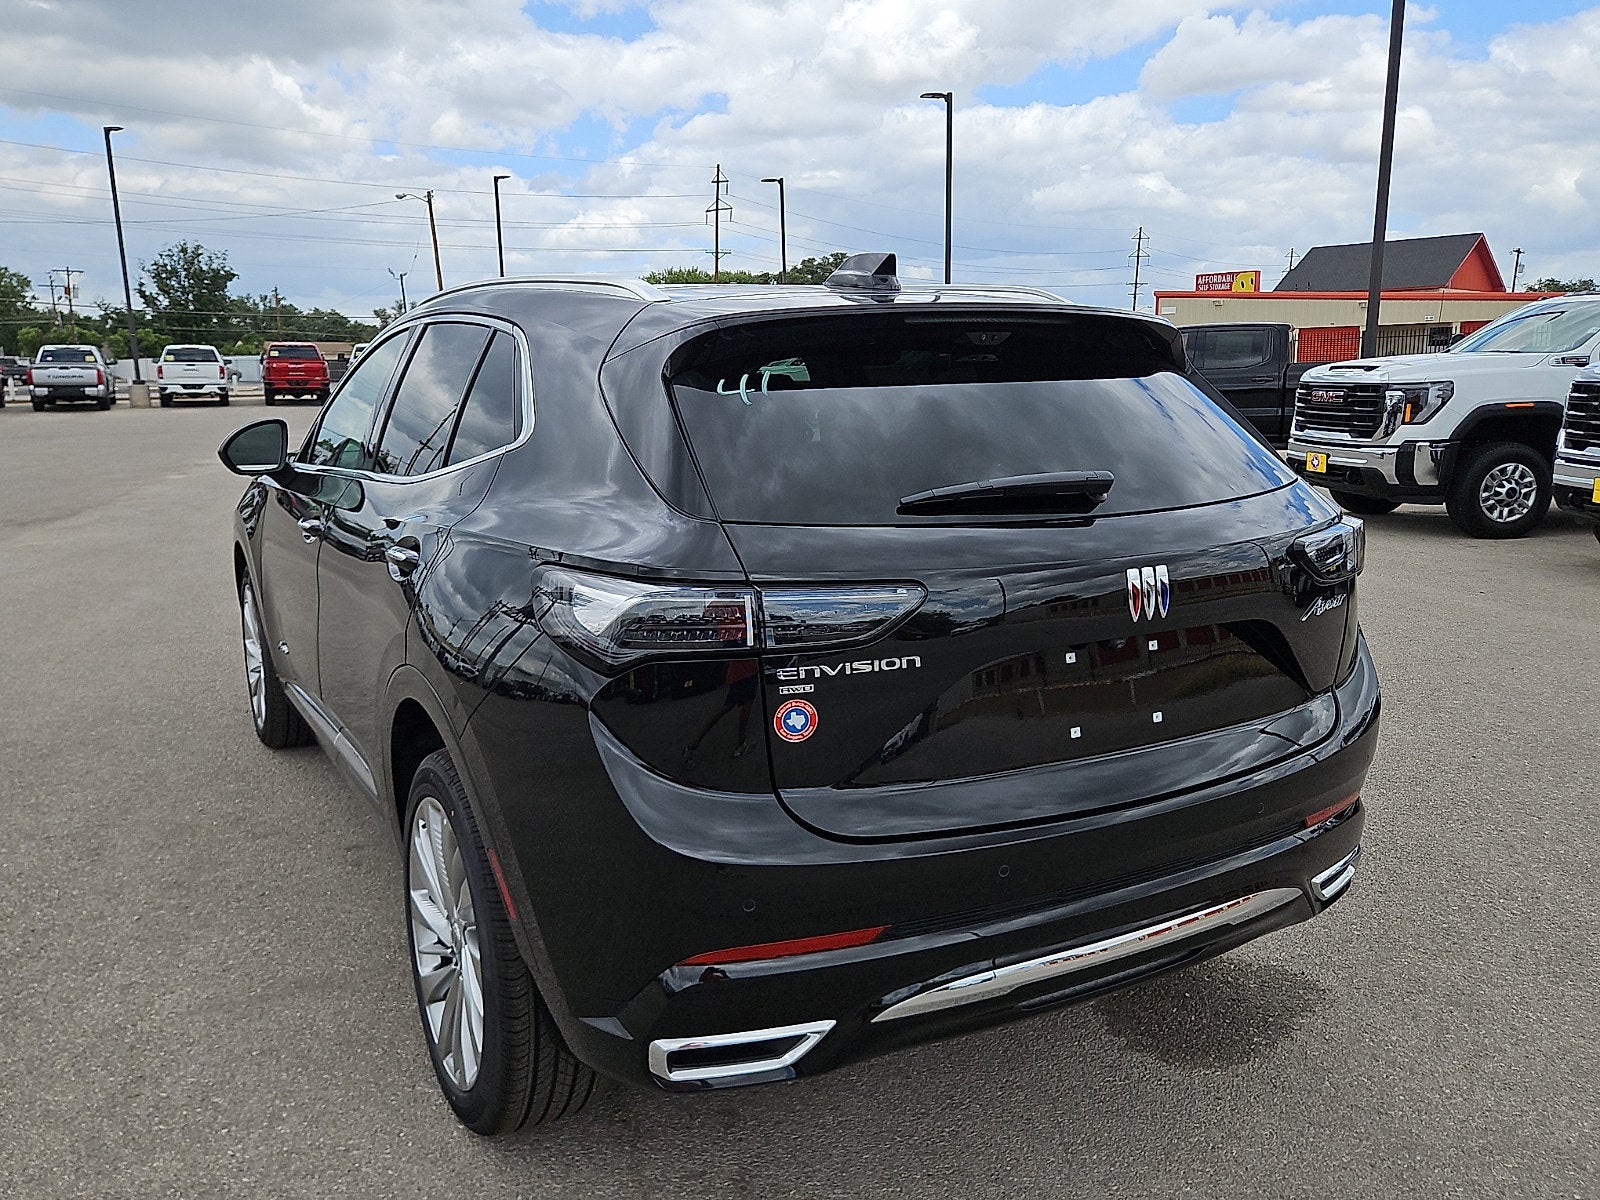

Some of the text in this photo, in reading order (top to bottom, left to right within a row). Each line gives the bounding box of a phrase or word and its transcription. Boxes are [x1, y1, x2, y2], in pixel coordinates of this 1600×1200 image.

[1198, 273, 1237, 284] AFFORDABLE
[1311, 390, 1345, 403] GMC
[776, 655, 922, 681] ENVISION
[779, 684, 814, 694] AWD
